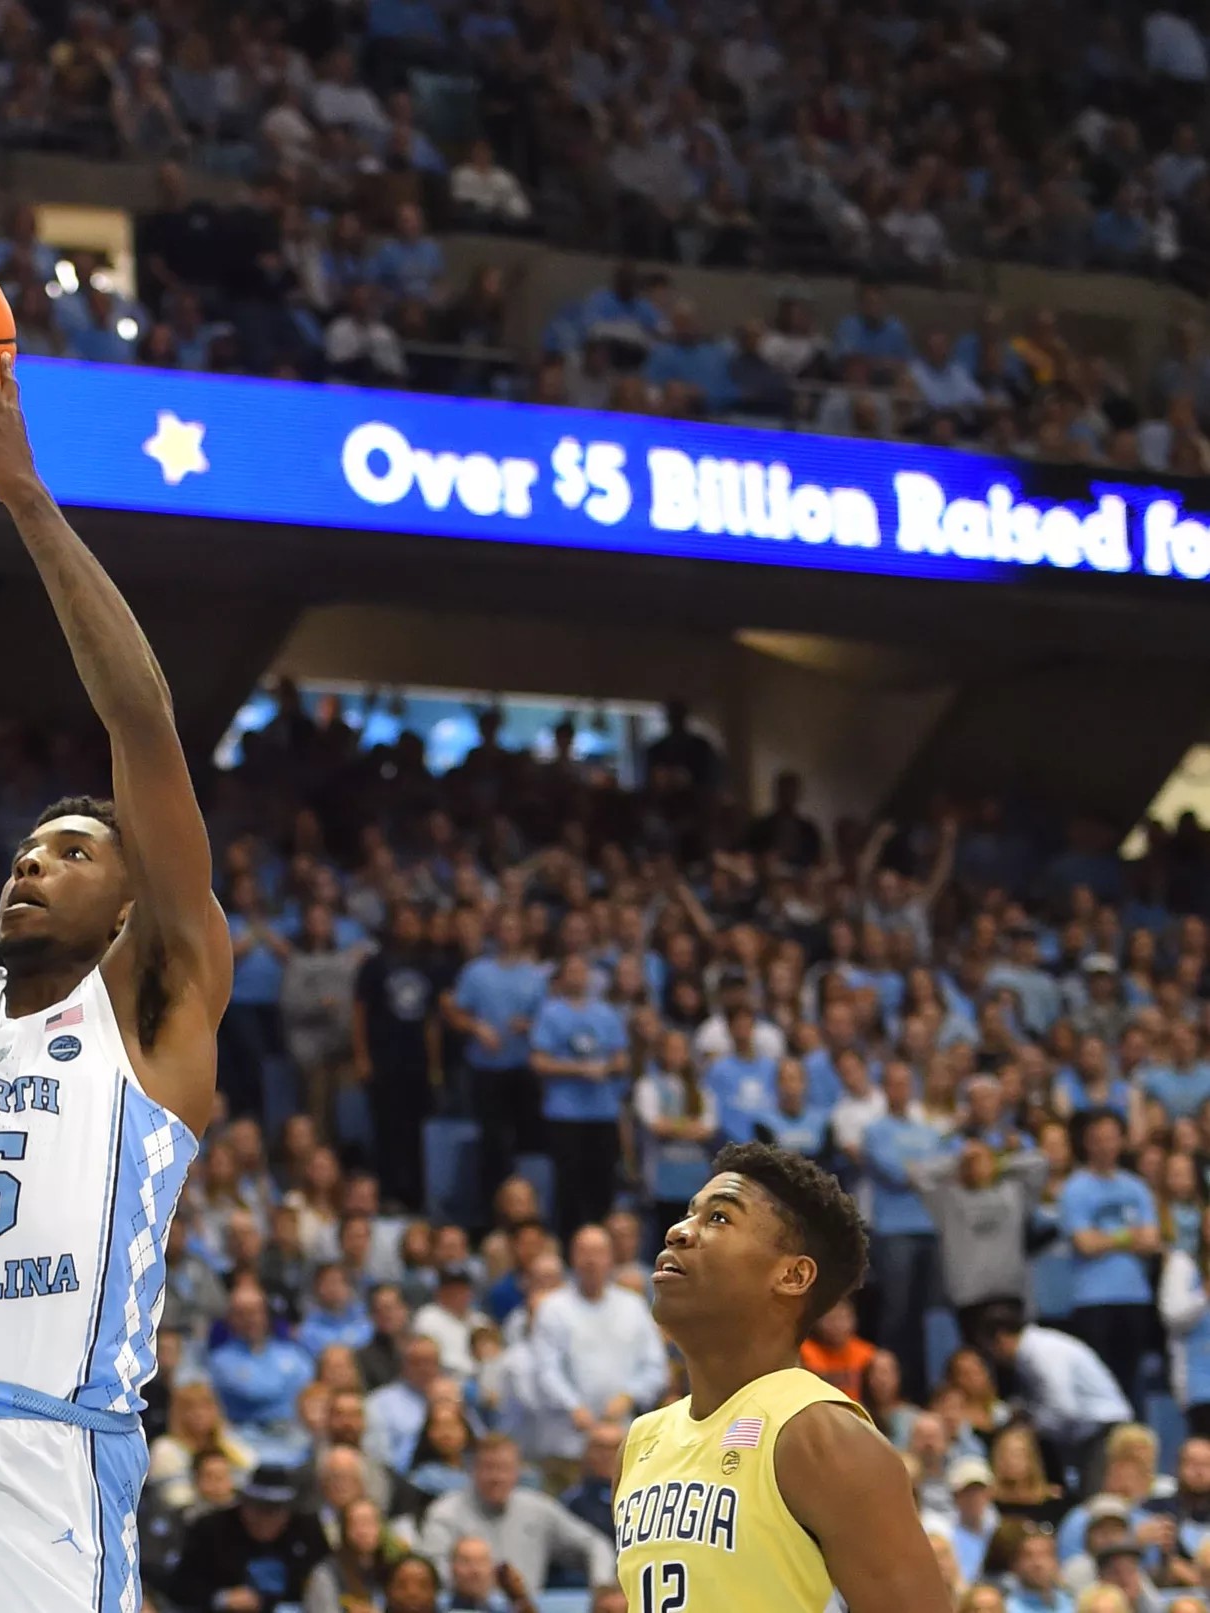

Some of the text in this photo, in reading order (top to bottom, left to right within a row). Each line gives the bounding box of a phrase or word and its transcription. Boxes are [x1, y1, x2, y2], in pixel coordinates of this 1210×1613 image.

[343, 420, 538, 519] Over
[551, 435, 632, 525] $5
[647, 447, 881, 548] Billion
[893, 470, 1132, 572] Raised
[640, 1561, 689, 1613] 12
